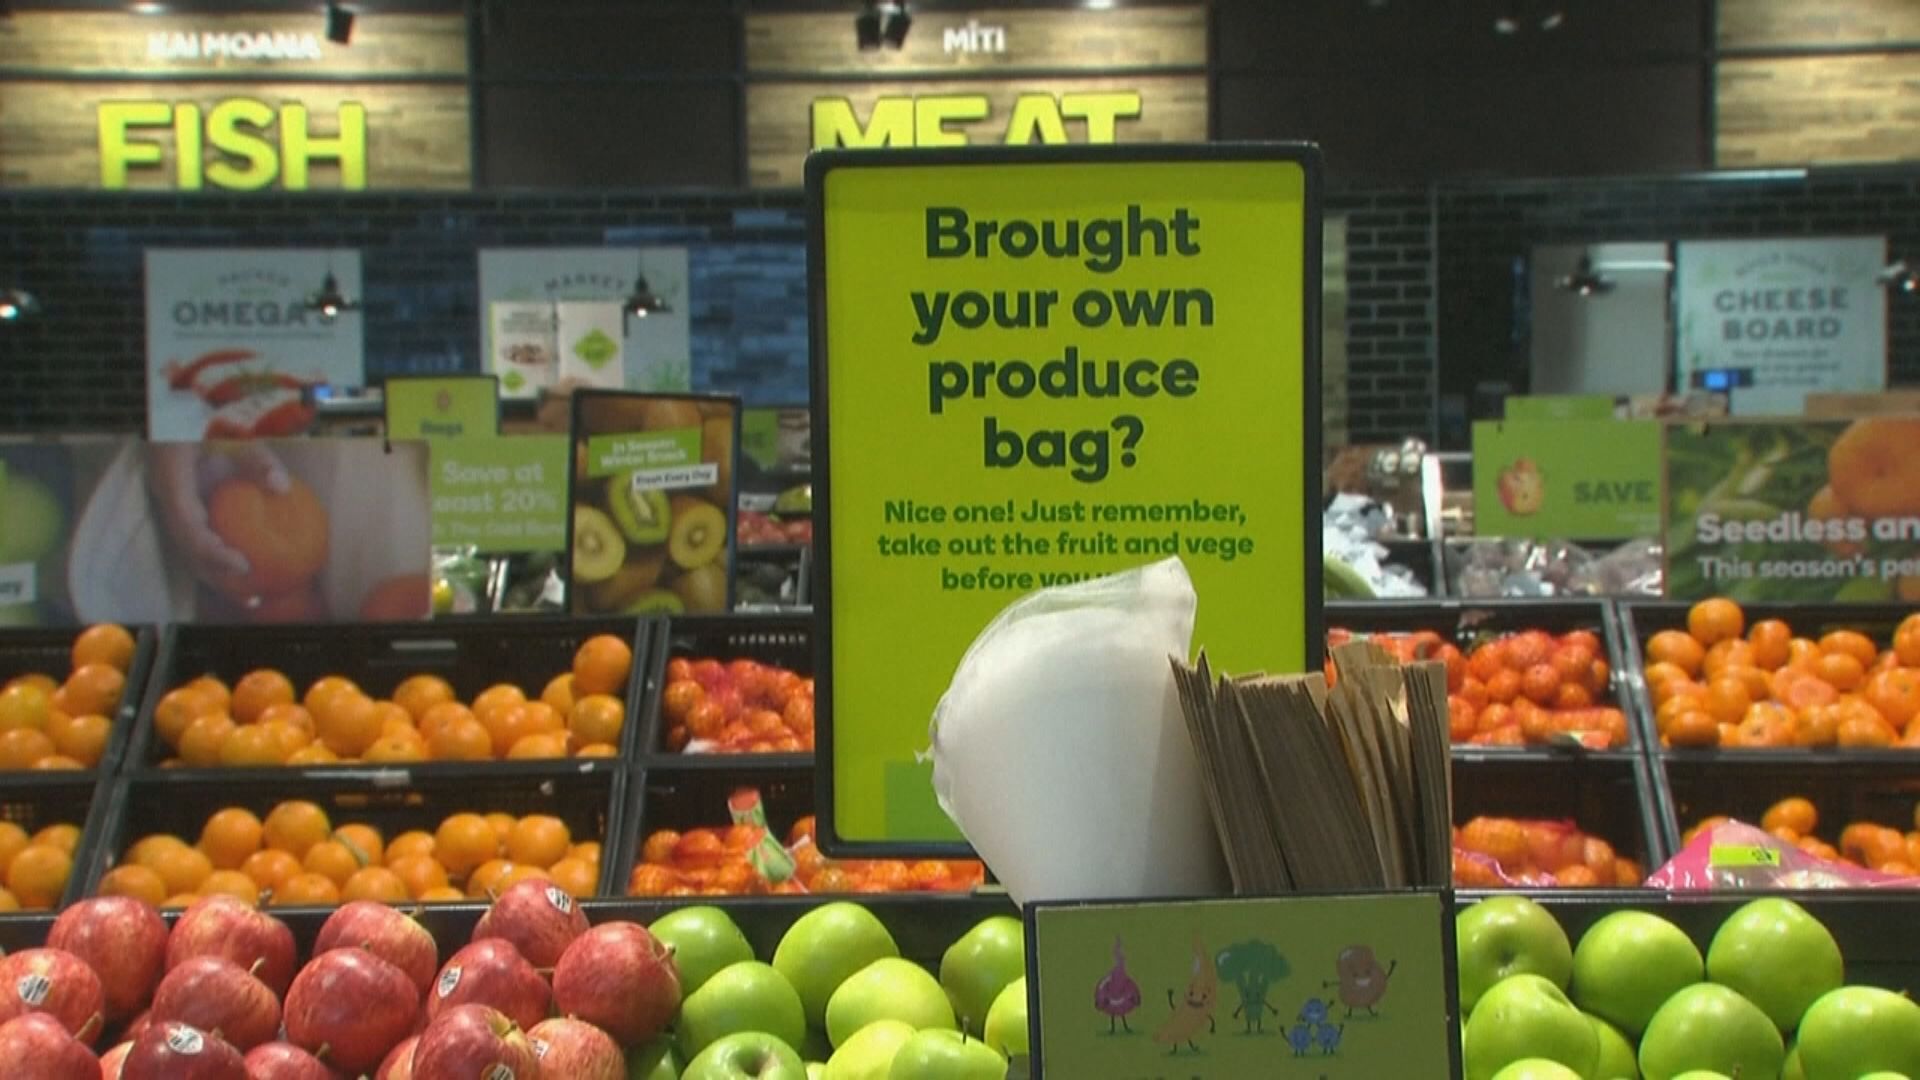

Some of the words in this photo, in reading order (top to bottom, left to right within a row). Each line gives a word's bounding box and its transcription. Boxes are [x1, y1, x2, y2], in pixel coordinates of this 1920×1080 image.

[148, 32, 198, 57] KAI
[203, 32, 320, 59] MOANA
[99, 98, 366, 190] FISH
[925, 204, 1201, 274] Brought
[1714, 286, 1849, 314] CHEESE
[910, 290, 1059, 345] your
[1072, 288, 1214, 328] own
[1724, 316, 1841, 341] BOARD
[928, 346, 1200, 414] produce
[983, 414, 1144, 484] bag?
[443, 461, 510, 484] Save
[514, 462, 543, 482] at
[433, 492, 495, 513] east
[1573, 480, 1655, 504] SAVE
[884, 500, 947, 523] Nice
[953, 499, 1014, 523] one!
[1020, 499, 1085, 523] Just
[1092, 499, 1246, 526] remember,
[1697, 511, 1867, 544] Seedless
[877, 533, 942, 556] take
[948, 534, 996, 555] out
[1002, 532, 1050, 555] the
[1057, 531, 1118, 555] fruit
[1124, 531, 1179, 554] and
[1185, 537, 1254, 561] vege
[942, 566, 1034, 590] before
[1697, 554, 1752, 578] This
[1759, 553, 1875, 578] season's
